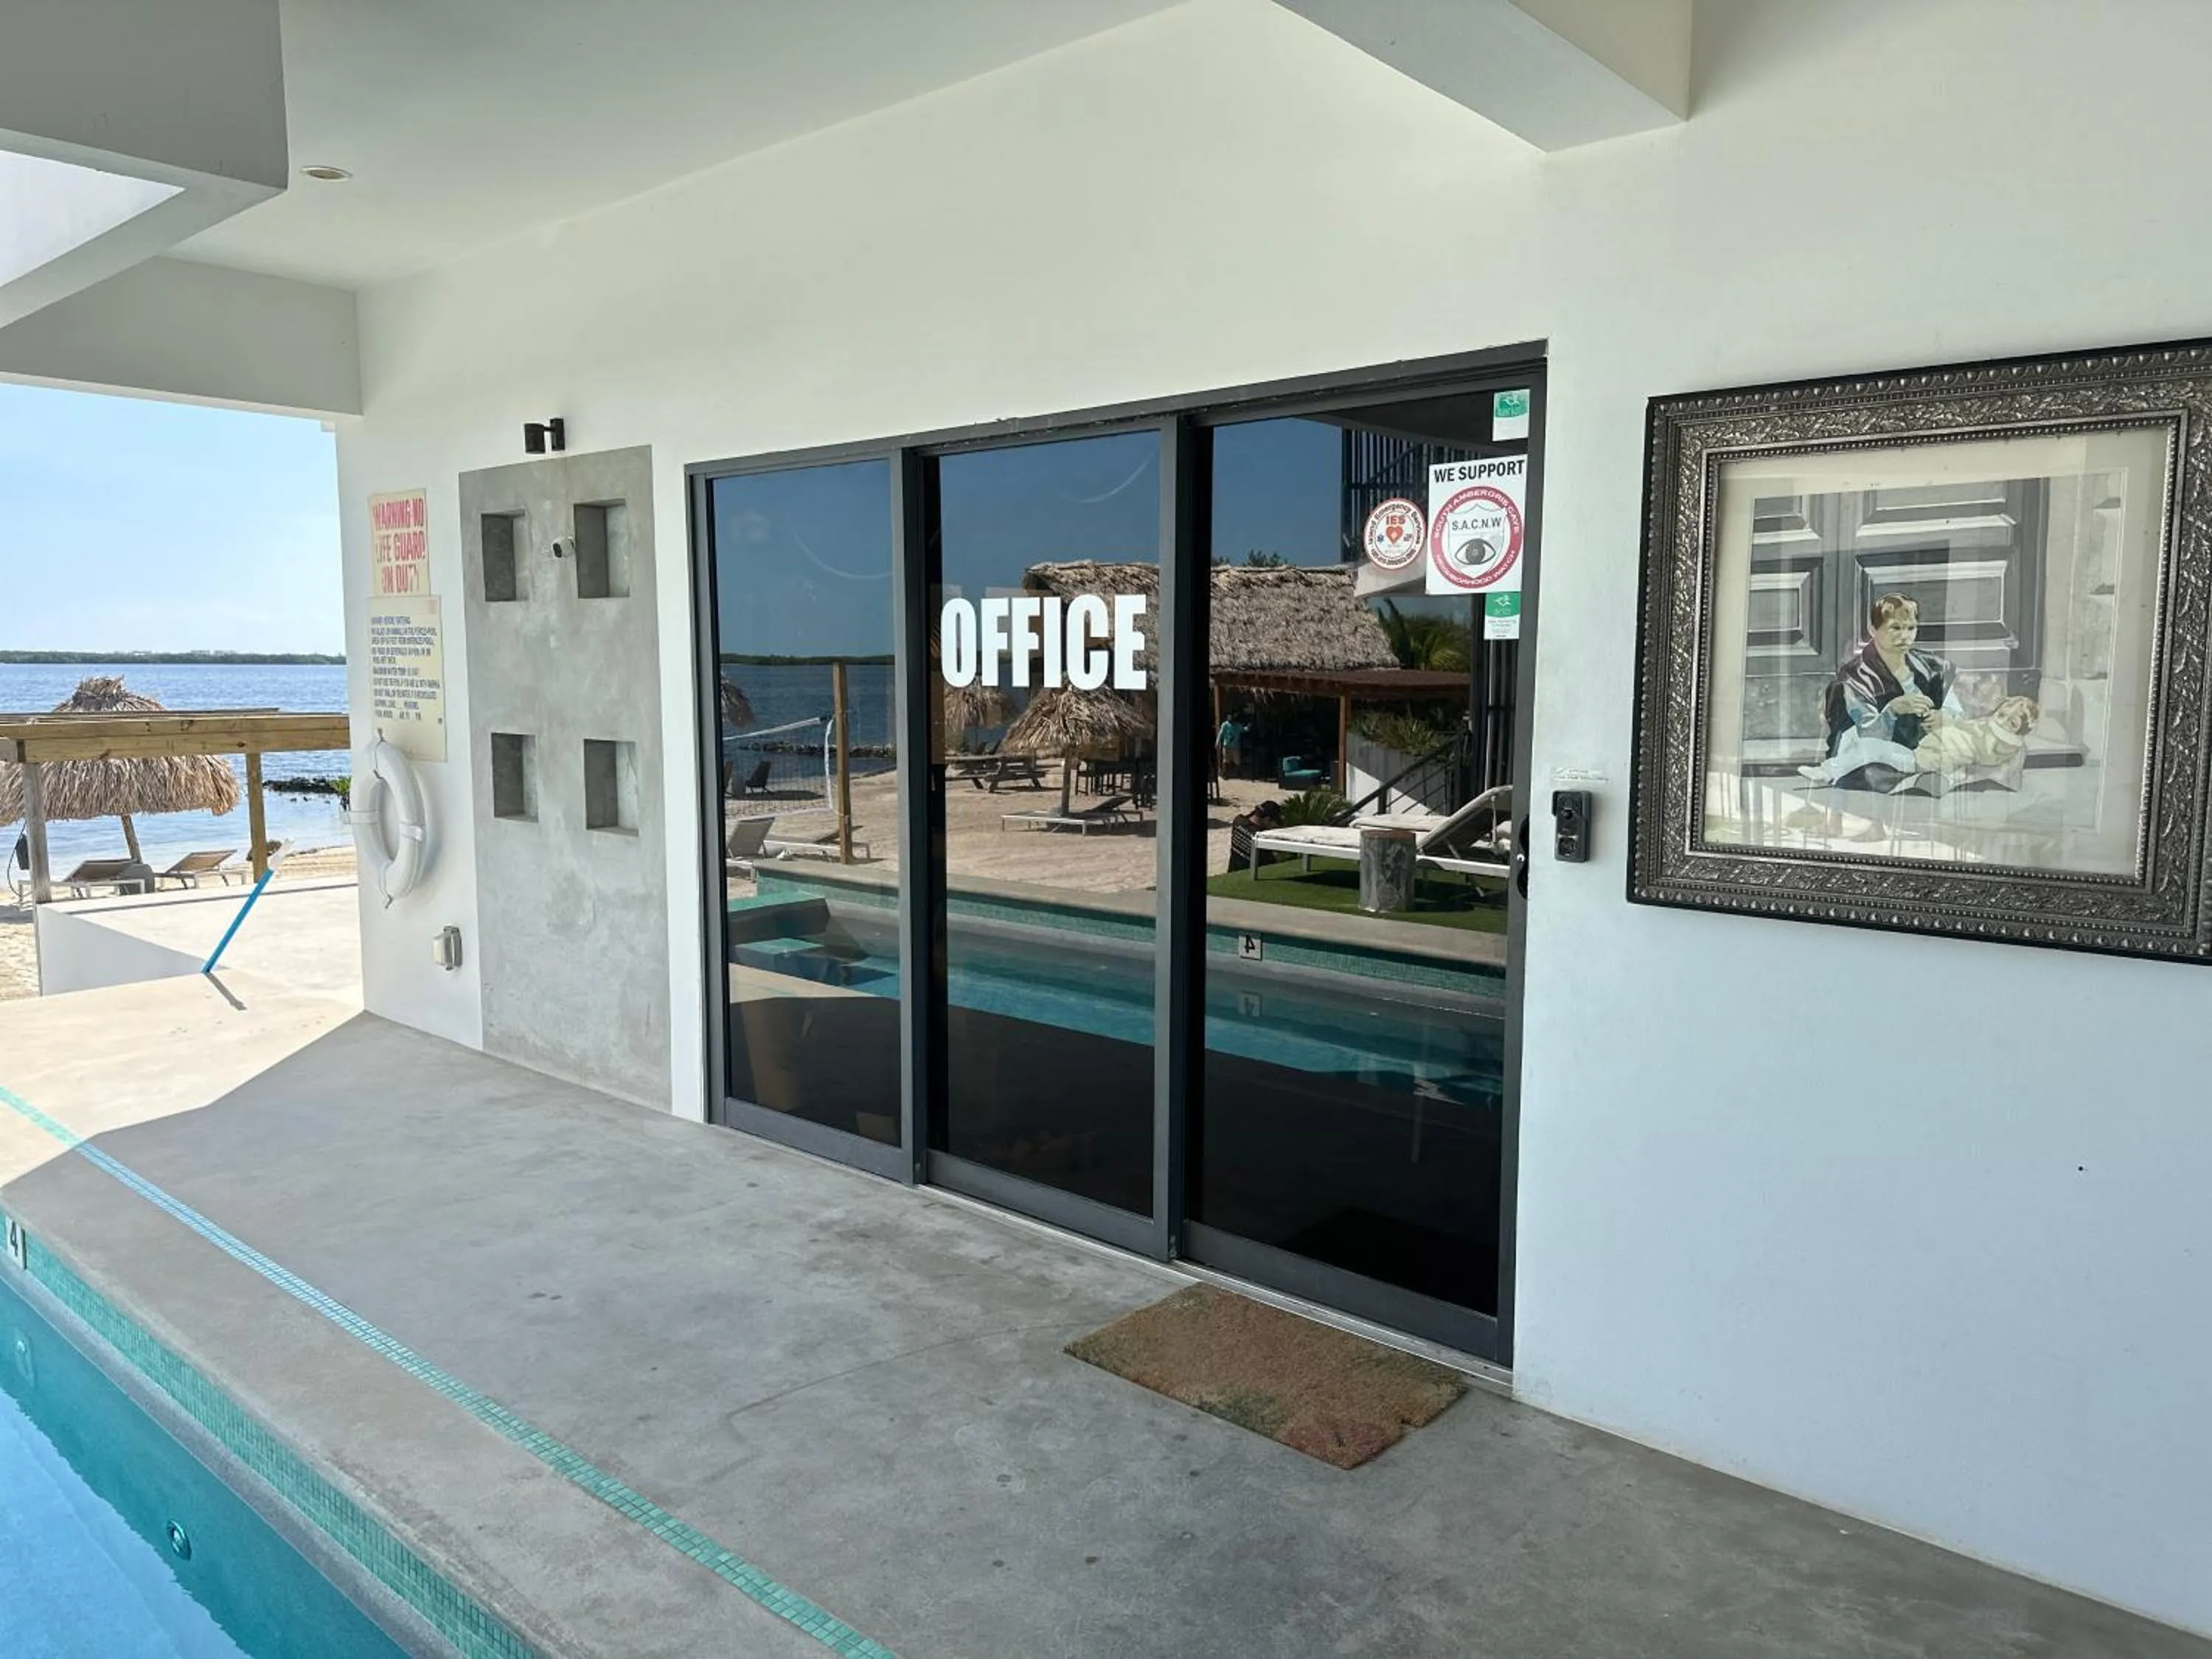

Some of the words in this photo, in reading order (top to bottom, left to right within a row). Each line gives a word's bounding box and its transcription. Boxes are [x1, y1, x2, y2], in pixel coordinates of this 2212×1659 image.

[1434, 467, 1455, 484] WE
[1458, 459, 1525, 481] SUPPORT
[372, 500, 411, 531] WARNING
[413, 498, 424, 527] NO
[1385, 514, 1407, 526] IES
[1434, 504, 1453, 539] SOUTH
[1453, 489, 1509, 507] AMBERGRIS
[1507, 506, 1520, 535] CAYE
[375, 533, 392, 564] LIFE
[1436, 554, 1492, 584] BORHOOD
[940, 594, 1147, 690] OFFICE
[10, 1220, 18, 1258] 4
